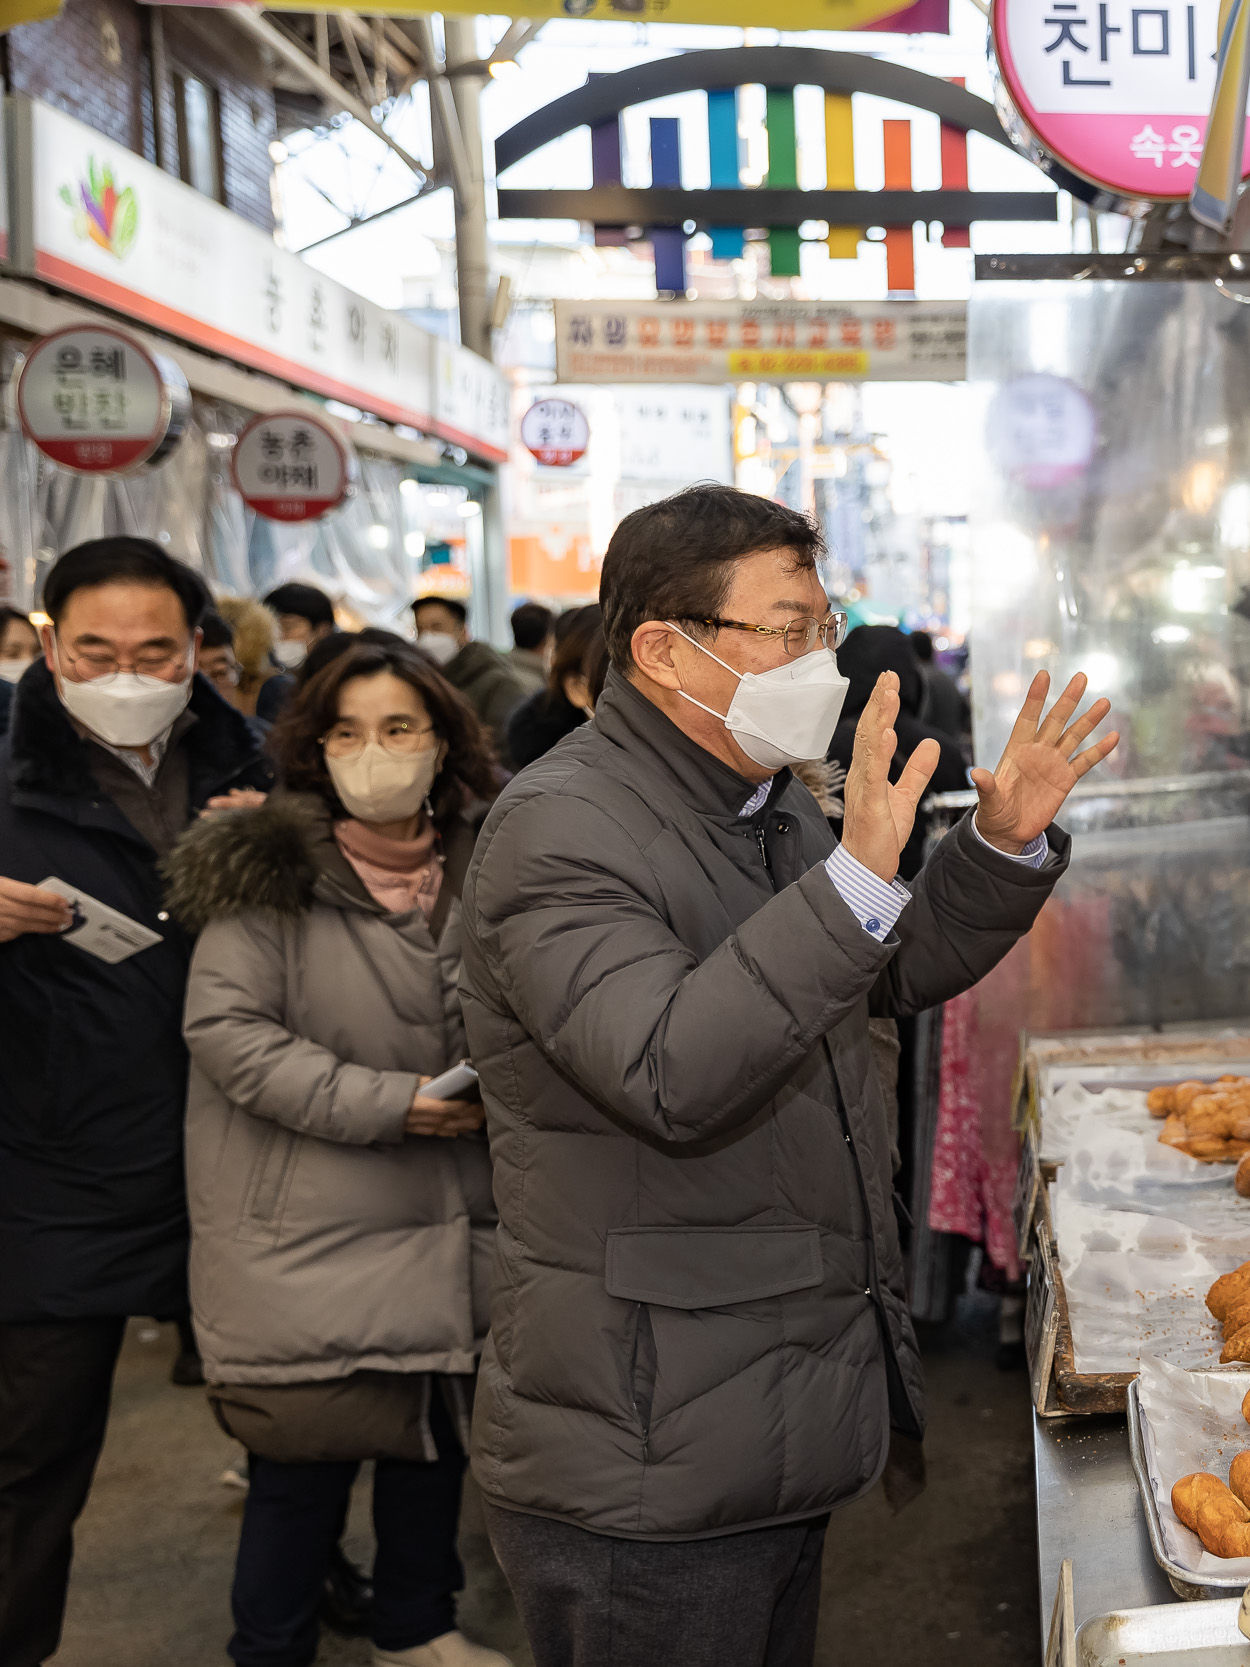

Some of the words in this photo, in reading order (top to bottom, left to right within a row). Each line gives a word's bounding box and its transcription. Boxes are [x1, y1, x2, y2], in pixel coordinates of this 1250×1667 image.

[1129, 124, 1204, 168] 속옷
[53, 345, 127, 387] 은혜
[54, 388, 128, 430] 반찬
[260, 429, 316, 463] 농촌
[257, 464, 319, 490] 야채
